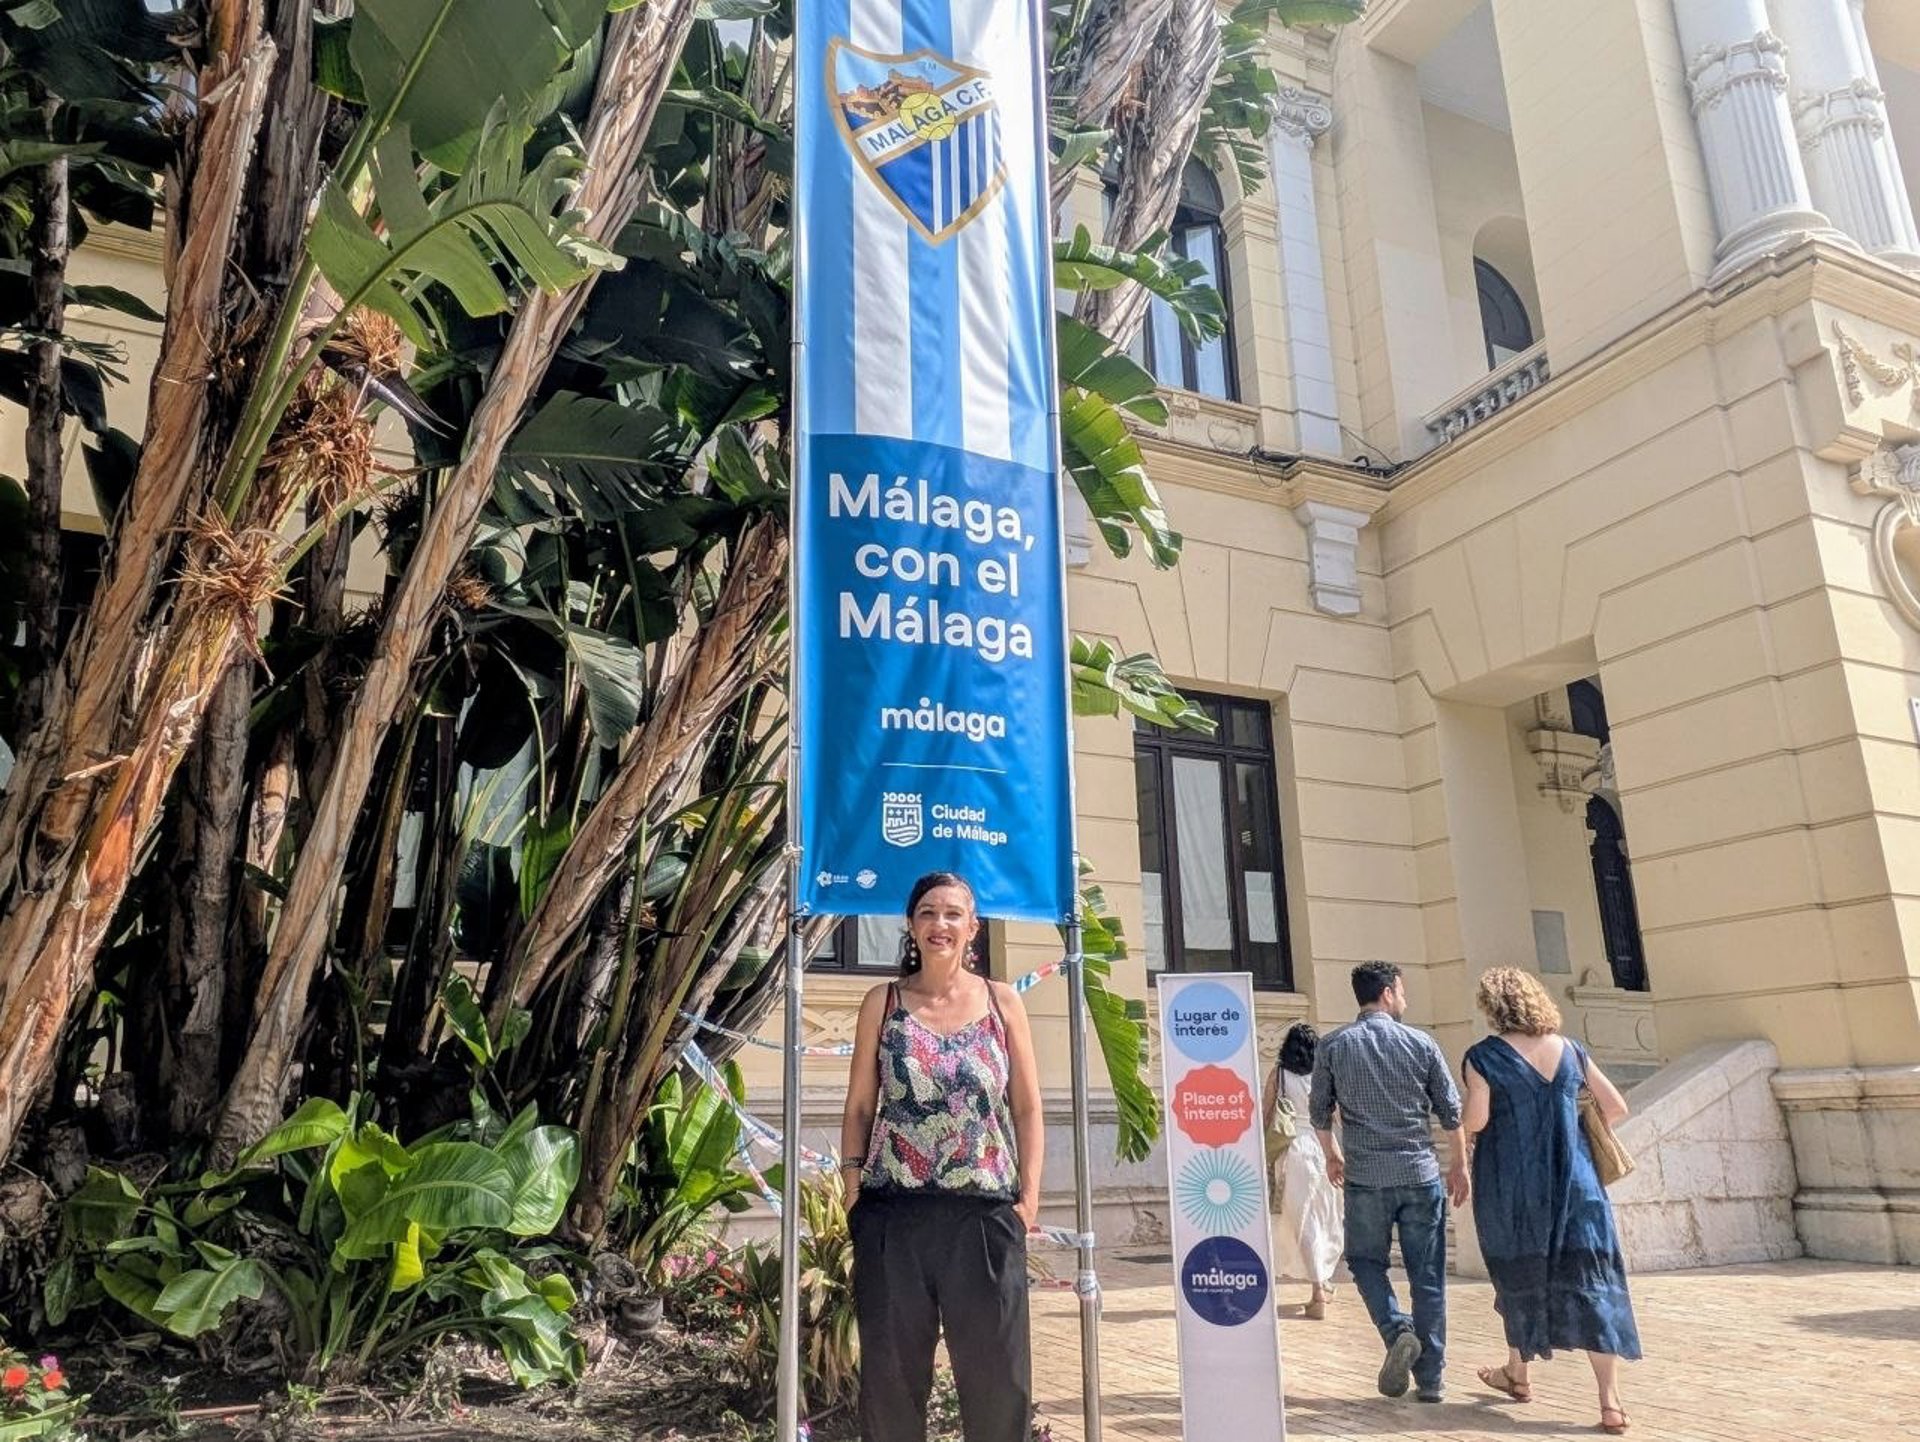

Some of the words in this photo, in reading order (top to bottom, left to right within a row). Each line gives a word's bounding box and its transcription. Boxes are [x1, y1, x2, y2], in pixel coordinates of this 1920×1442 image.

[866, 98, 958, 152] MALAGA
[956, 81, 993, 106] C.F.
[828, 473, 1036, 551] Málaga,
[855, 543, 960, 587] con
[977, 552, 1019, 597] el
[839, 592, 1033, 663] Málaga
[931, 804, 986, 822] Ciudad
[932, 824, 953, 838] de
[956, 824, 1007, 846] Málaga
[1174, 1009, 1217, 1025] Lugar
[1221, 1008, 1240, 1021] de
[1182, 1091, 1225, 1105] Place
[1228, 1090, 1246, 1104] of
[1184, 1107, 1246, 1120] interest
